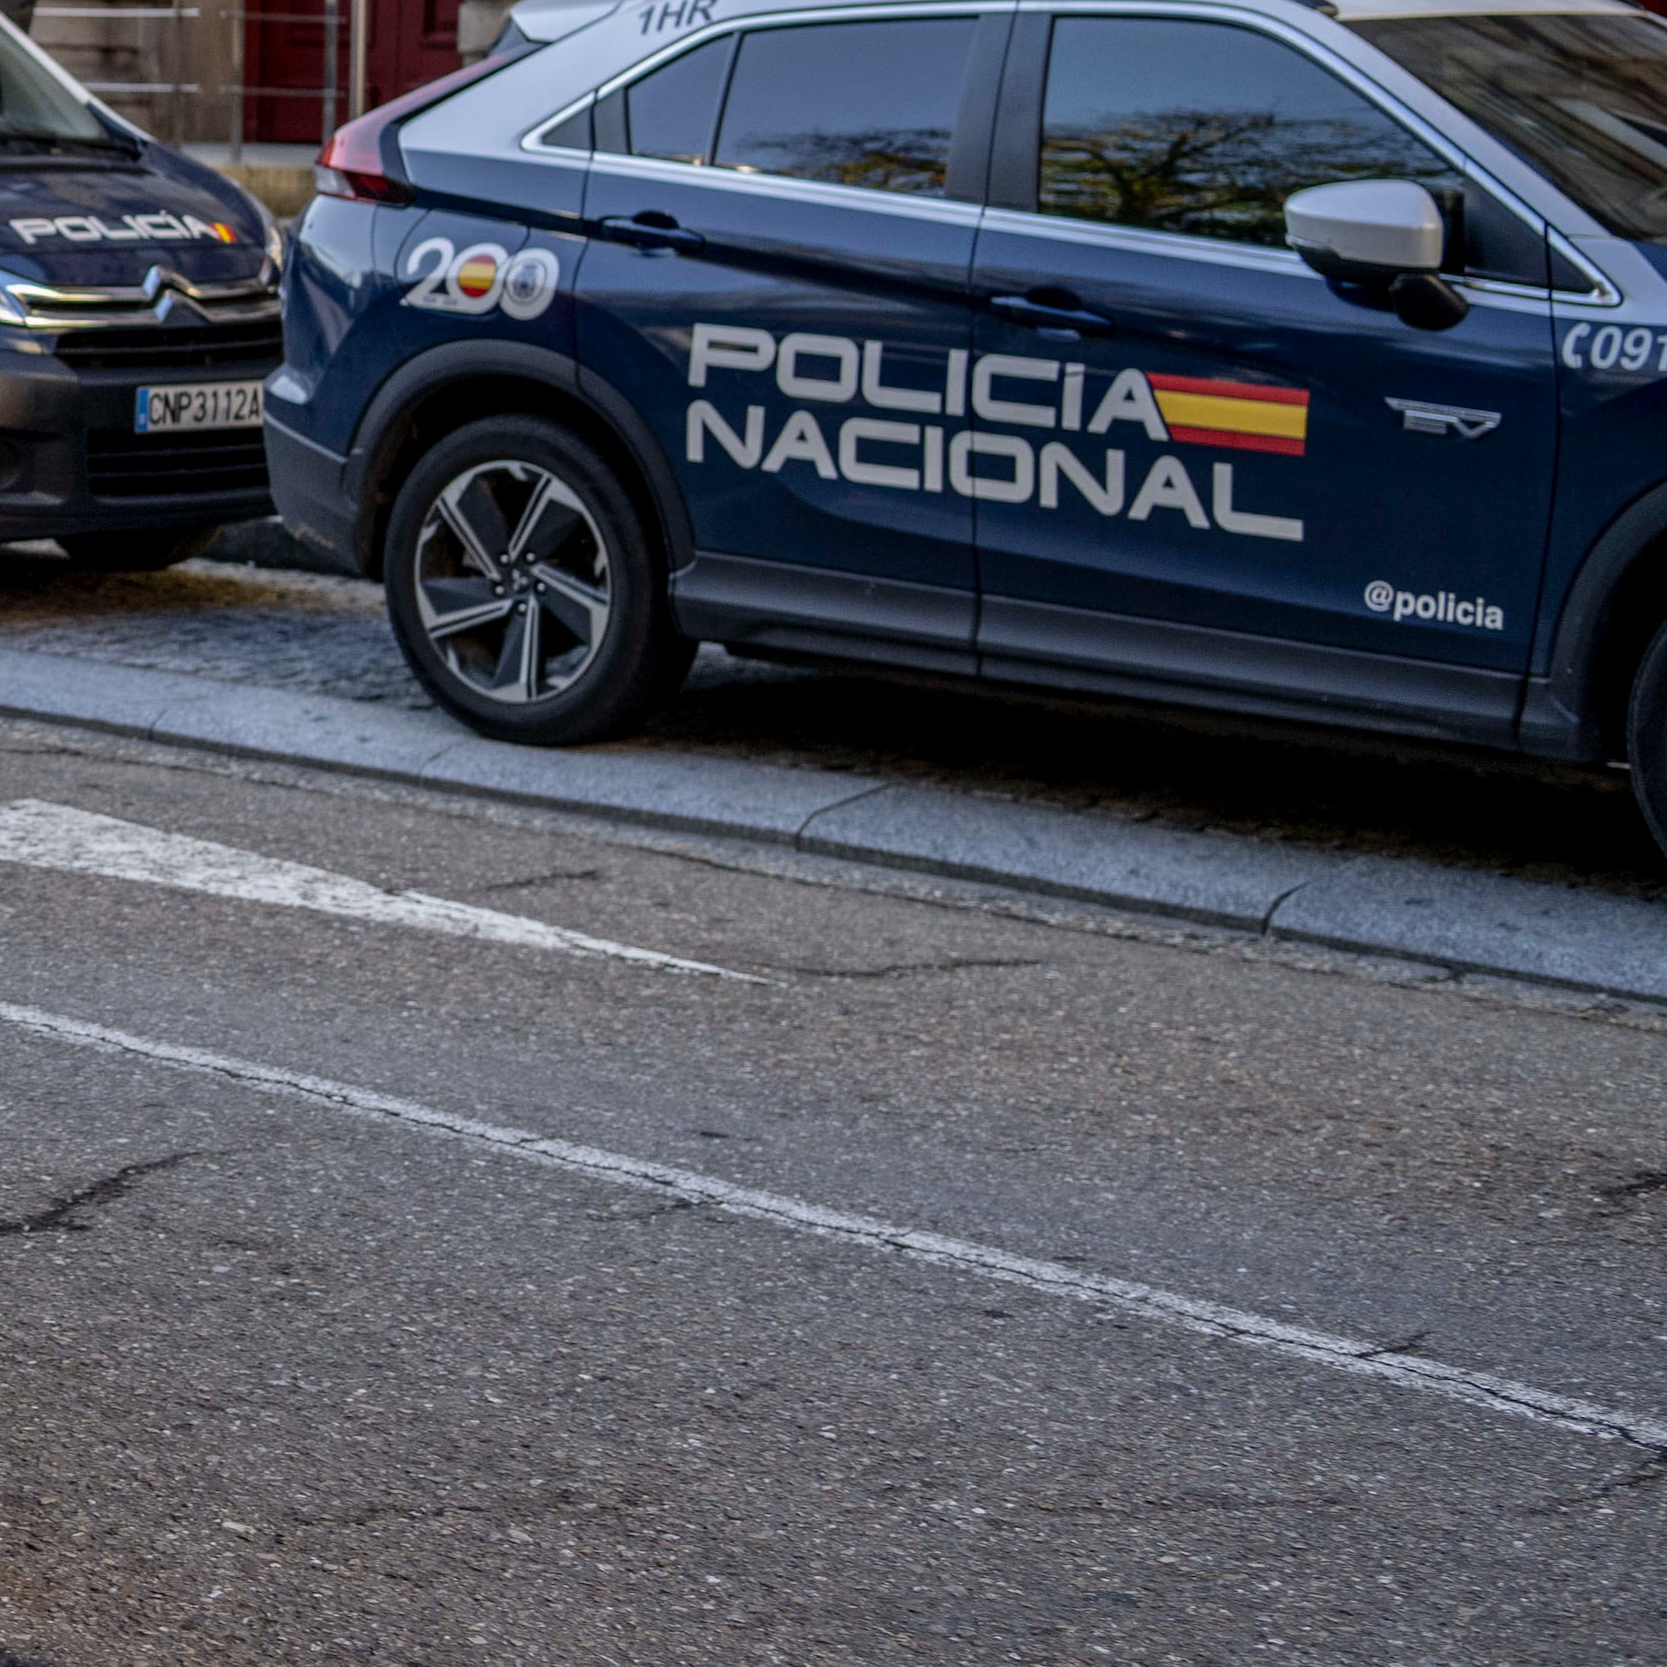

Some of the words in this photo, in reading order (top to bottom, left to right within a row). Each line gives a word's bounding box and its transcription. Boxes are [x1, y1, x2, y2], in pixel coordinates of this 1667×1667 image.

[8, 209, 221, 245] POLICÍA
[399, 236, 560, 321] 200
[685, 399, 1305, 542] NACIONAL
[1363, 580, 1504, 631] @policia
